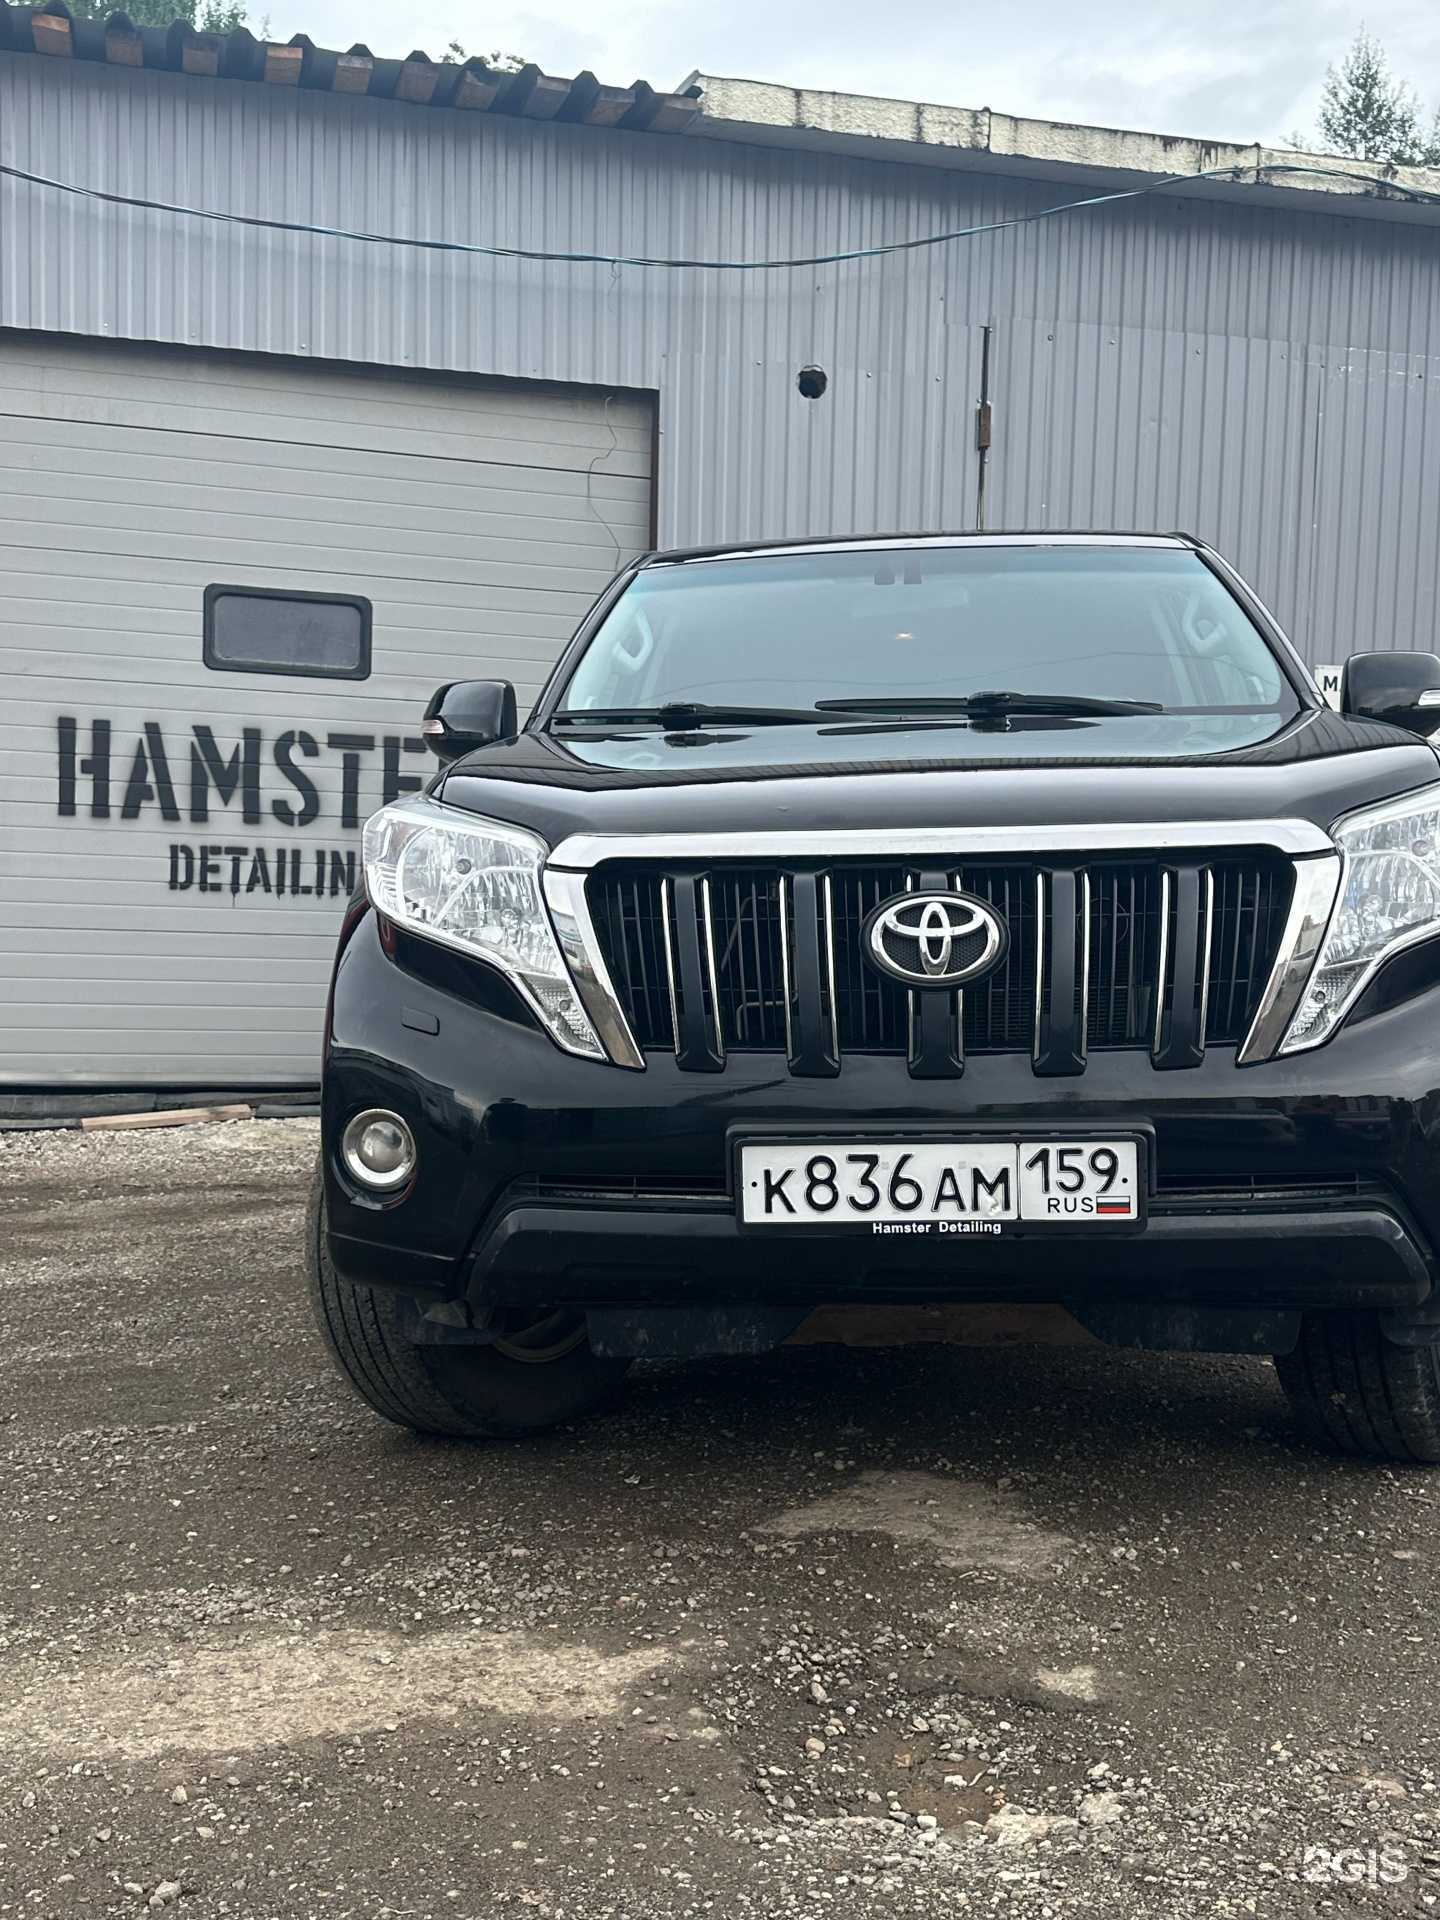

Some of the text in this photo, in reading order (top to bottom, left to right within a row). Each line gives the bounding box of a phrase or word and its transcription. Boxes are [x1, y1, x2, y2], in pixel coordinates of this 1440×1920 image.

[57, 716, 446, 829] HAMSTE
[169, 844, 356, 897] DETAILIN
[1026, 1147, 1119, 1193] 159
[872, 1221, 1002, 1235] Hamster Detailing
[1047, 1197, 1094, 1213] RUS
